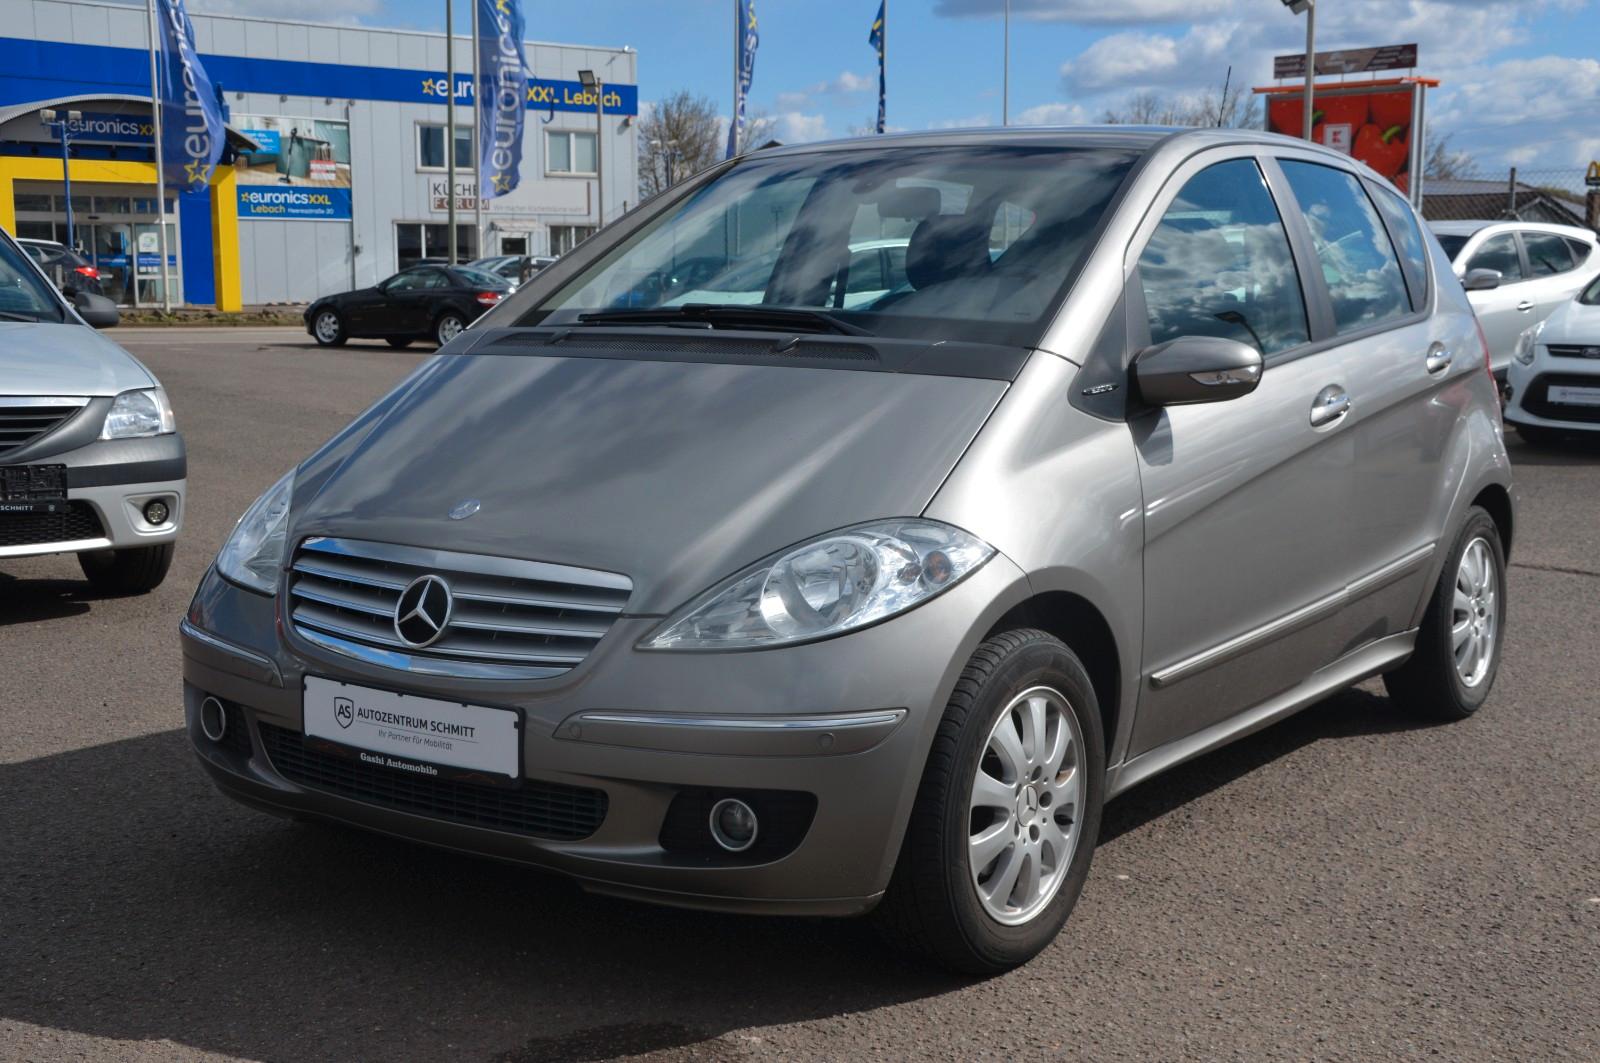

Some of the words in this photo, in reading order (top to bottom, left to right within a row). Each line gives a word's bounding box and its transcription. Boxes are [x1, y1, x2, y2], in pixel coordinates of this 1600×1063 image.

[250, 203, 286, 214] Lebach
[337, 703, 352, 719] AS
[357, 707, 428, 730] AUTOZENTRUM
[430, 720, 476, 738] SCHMITT
[378, 729, 387, 738] Ihr
[387, 730, 412, 743] Partner
[412, 735, 423, 745] für
[423, 738, 453, 751] Mobilität
[360, 752, 385, 765] Gashi
[386, 758, 438, 776] Automobile
